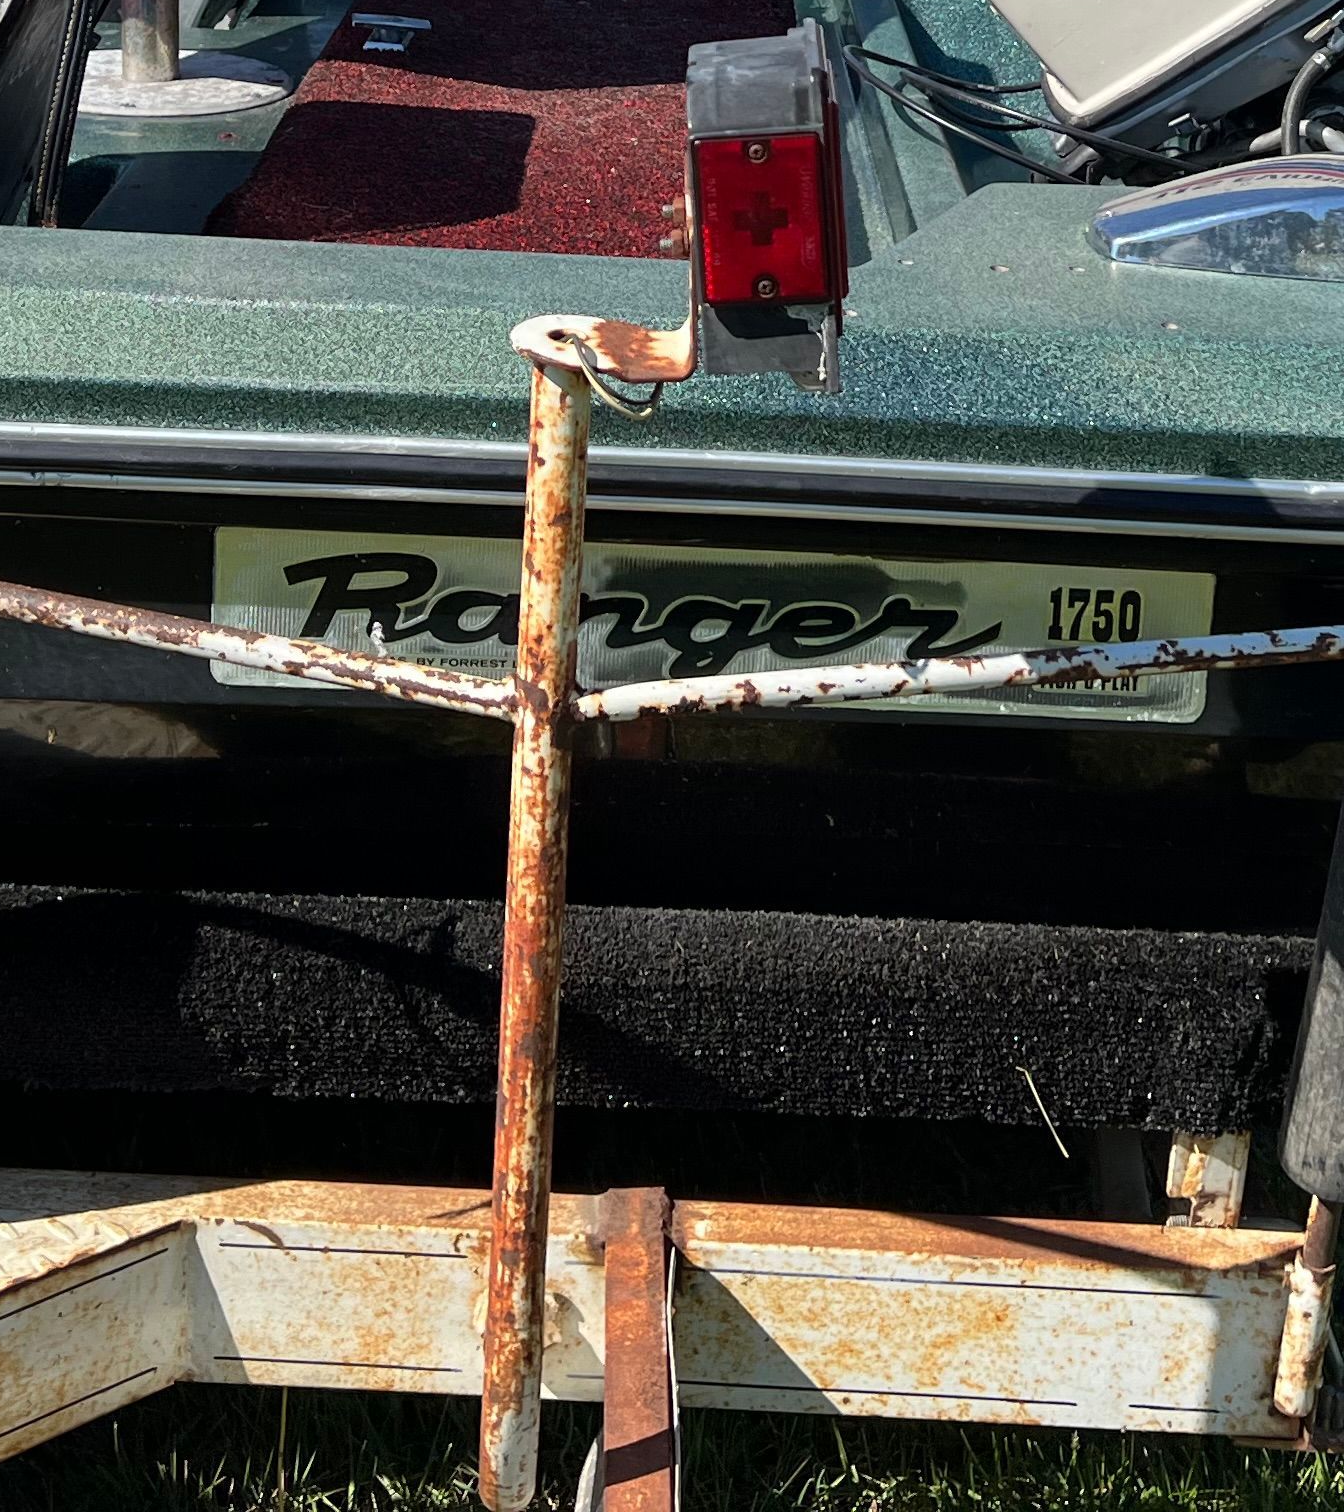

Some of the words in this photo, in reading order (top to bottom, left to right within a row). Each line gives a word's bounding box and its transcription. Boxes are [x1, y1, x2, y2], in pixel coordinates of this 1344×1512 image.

[283, 552, 1002, 678] Ranger
[1047, 586, 1142, 642] 1750
[440, 657, 508, 668] FORREST
